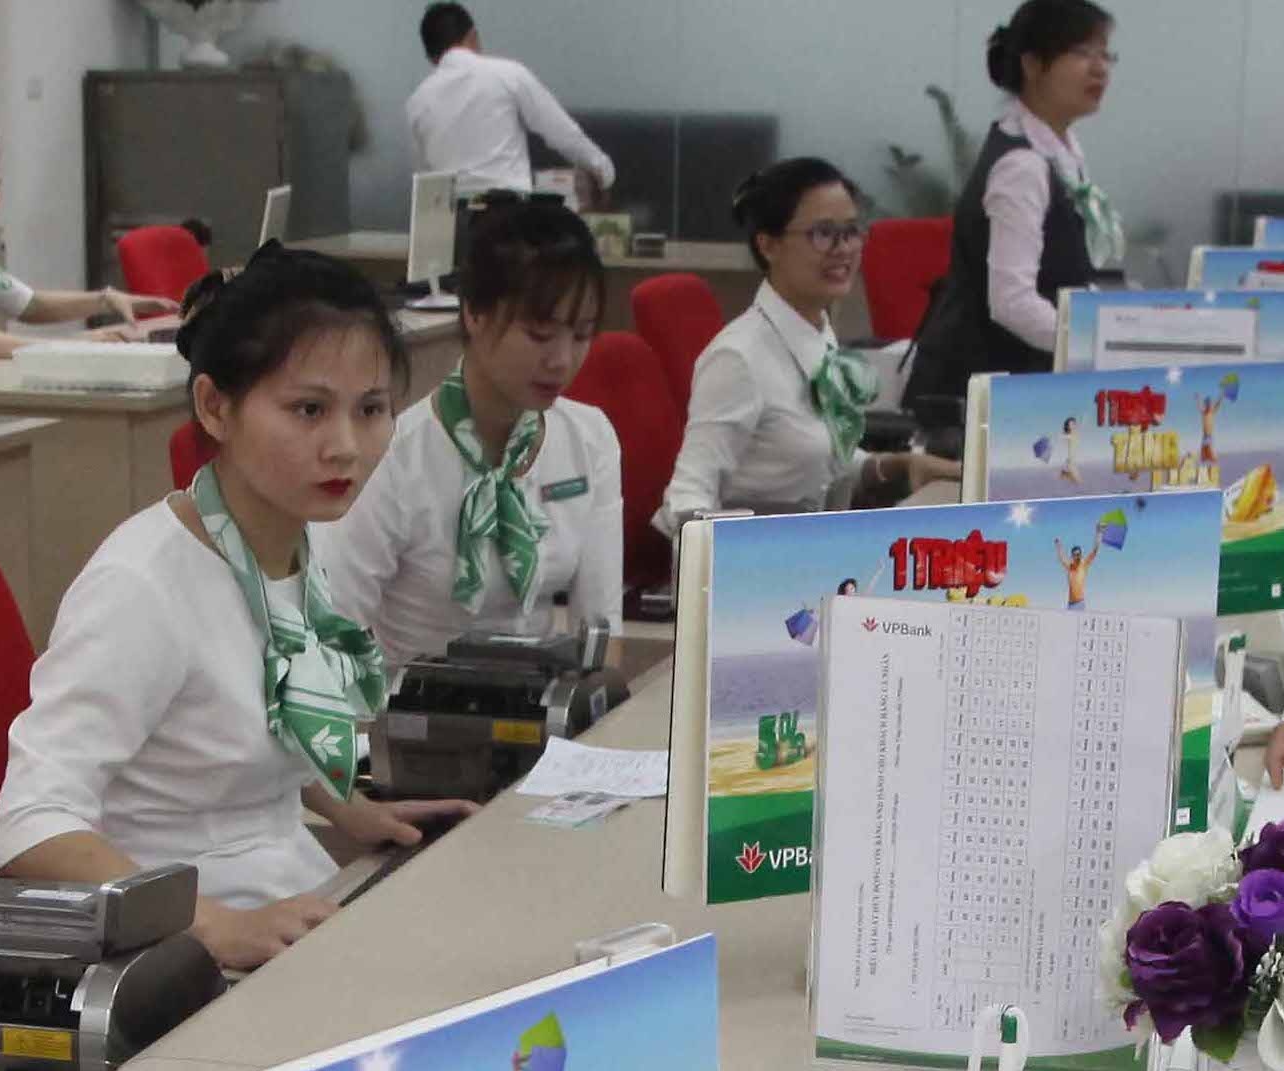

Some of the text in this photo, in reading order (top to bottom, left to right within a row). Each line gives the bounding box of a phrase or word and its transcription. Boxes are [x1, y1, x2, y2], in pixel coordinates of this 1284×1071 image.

[1094, 389, 1106, 427] 1
[890, 529, 1008, 598] 1 TRIỆU
[882, 621, 933, 638] VPBank
[757, 711, 806, 770] 5%
